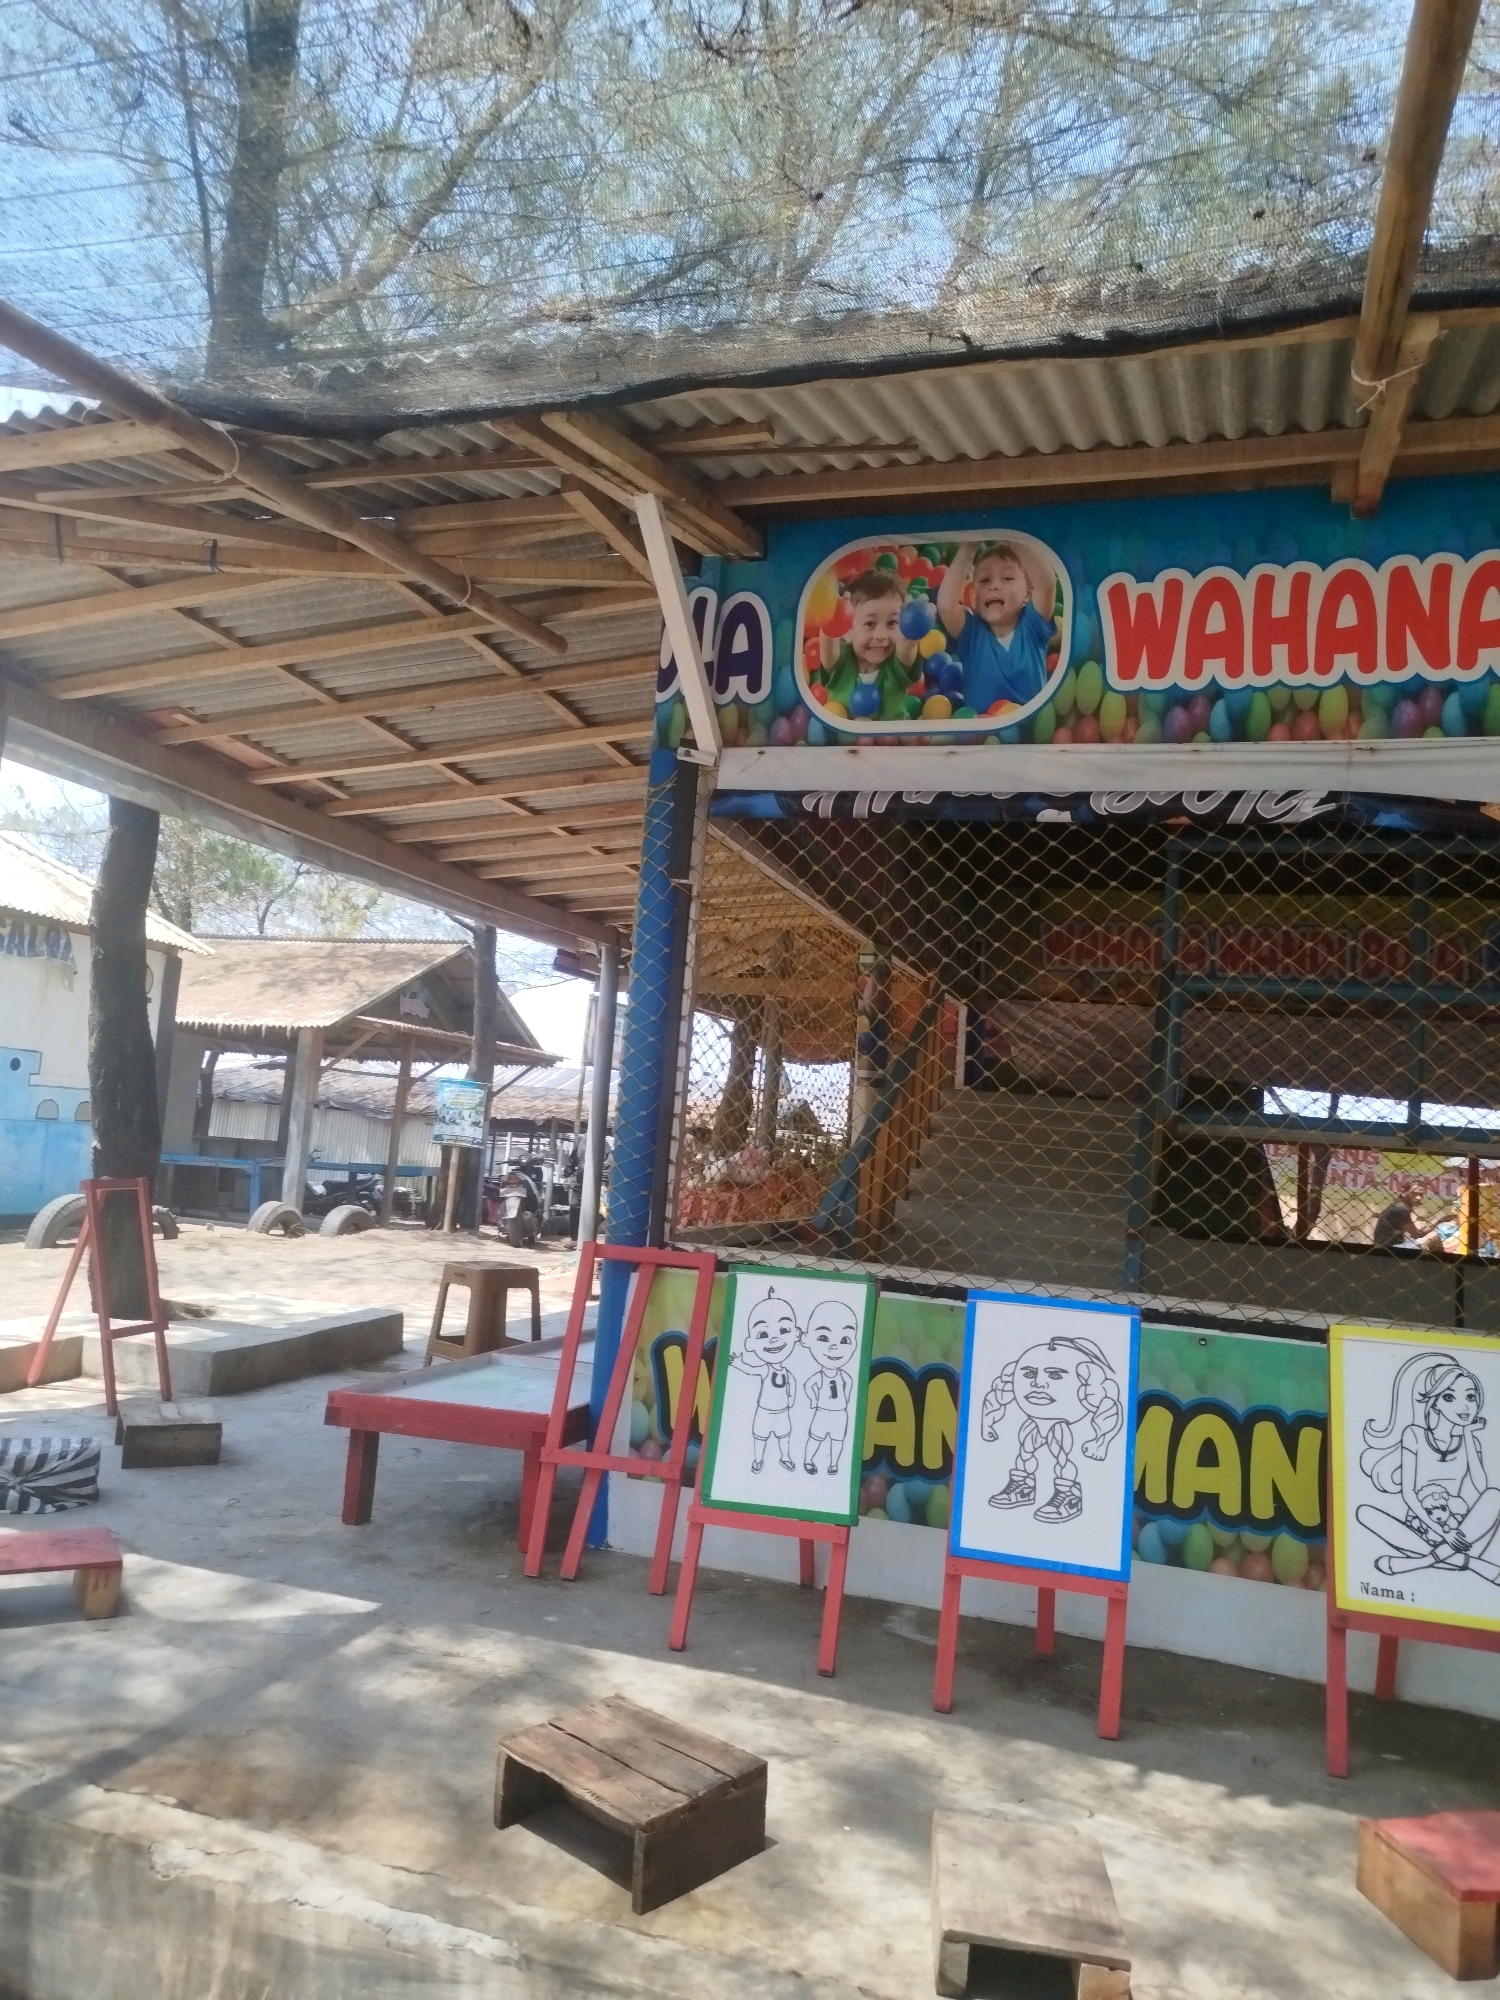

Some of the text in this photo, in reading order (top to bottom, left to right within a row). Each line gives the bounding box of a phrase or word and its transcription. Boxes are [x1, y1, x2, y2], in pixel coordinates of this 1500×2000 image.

[1107, 559, 1500, 681] WAHANA
[771, 1370, 787, 1389] U
[1360, 1581, 1405, 1601] Nama
